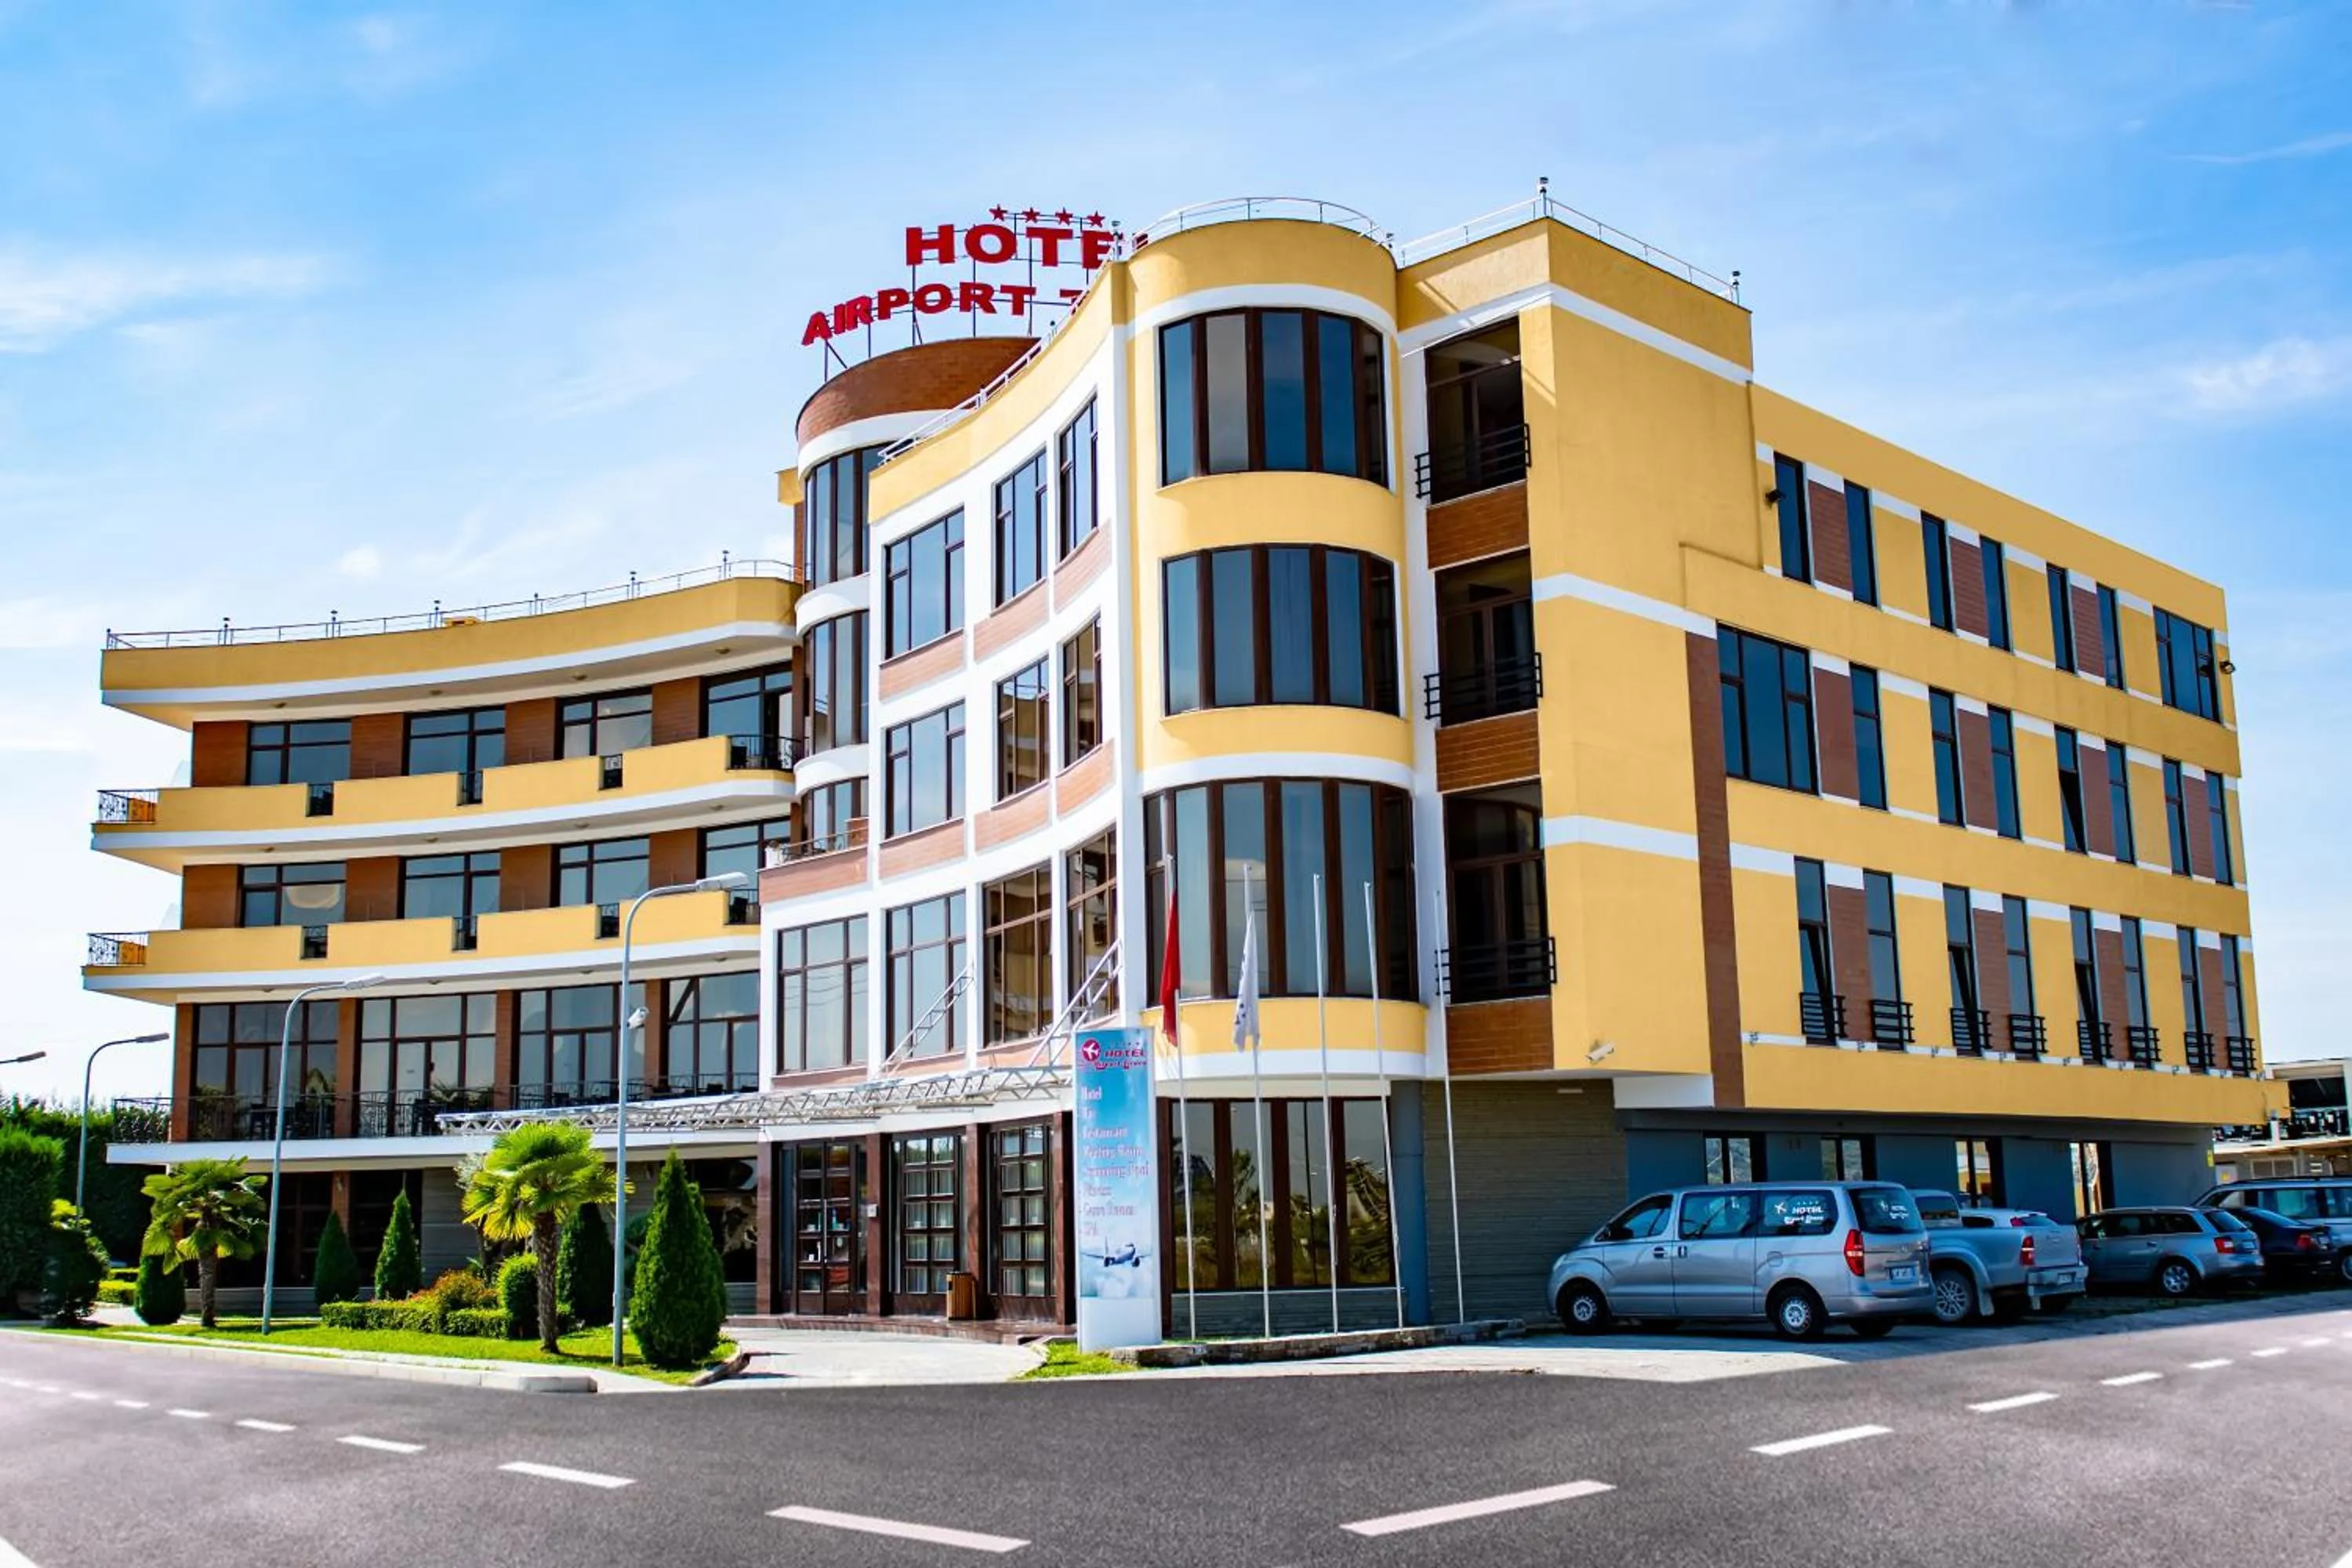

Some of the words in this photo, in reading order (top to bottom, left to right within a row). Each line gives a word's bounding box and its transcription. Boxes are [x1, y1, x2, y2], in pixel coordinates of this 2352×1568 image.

[906, 224, 1147, 269] HOTE
[802, 282, 1036, 346] AIRPORT
[1105, 1047, 1145, 1058] HOTEL
